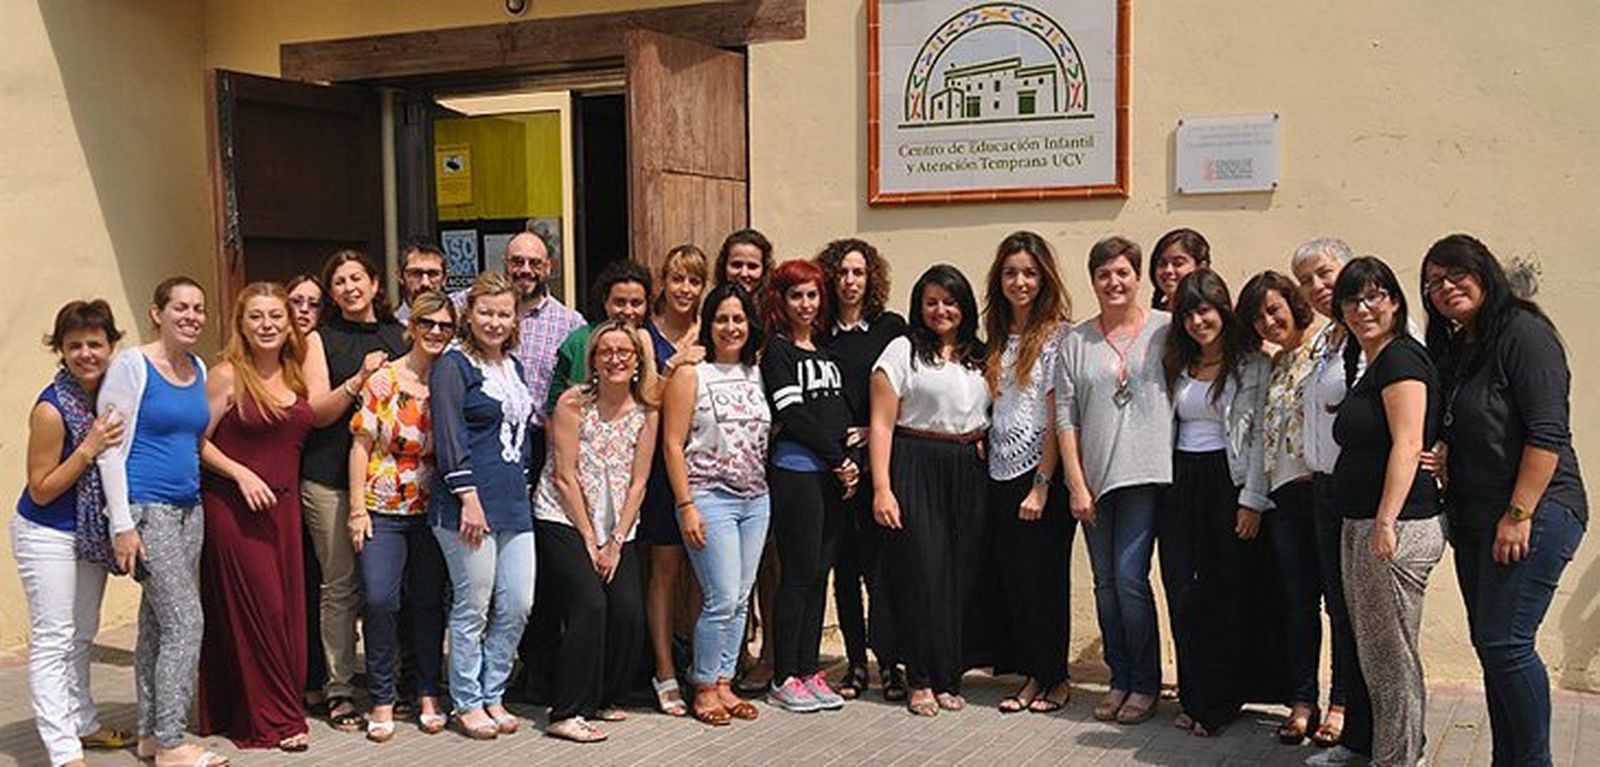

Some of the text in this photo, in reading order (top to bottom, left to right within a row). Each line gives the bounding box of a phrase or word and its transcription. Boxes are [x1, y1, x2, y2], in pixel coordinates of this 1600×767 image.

[899, 134, 1094, 156] Centro de Educación Infantil
[917, 158, 977, 173] Atención
[980, 155, 1047, 171] Temprana
[1052, 153, 1085, 167] UCV
